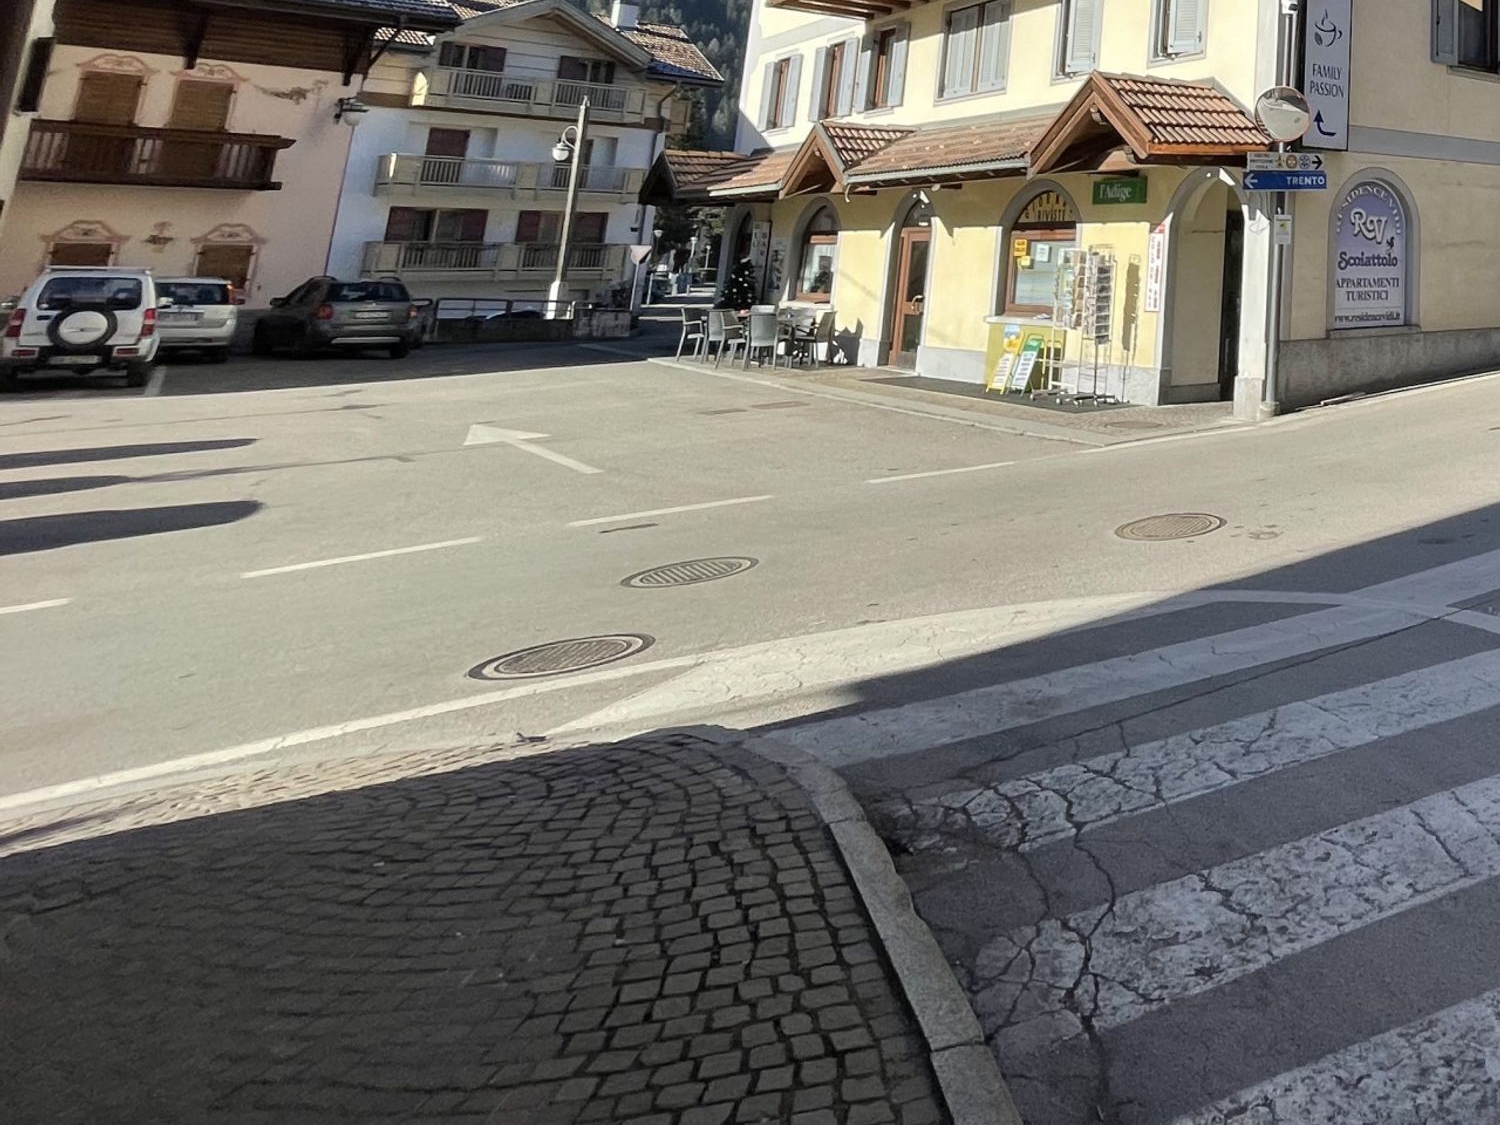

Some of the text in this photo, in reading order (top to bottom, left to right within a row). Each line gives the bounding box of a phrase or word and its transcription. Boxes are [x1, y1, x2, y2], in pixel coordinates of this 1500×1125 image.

[1312, 63, 1342, 80] FAMILY
[1310, 80, 1345, 98] PASSION
[1286, 176, 1326, 185] TRENTO
[1338, 250, 1399, 270] Scoiattolo
[1336, 277, 1400, 289] APPARTAMENTI
[1346, 289, 1389, 302] TURISTICI
